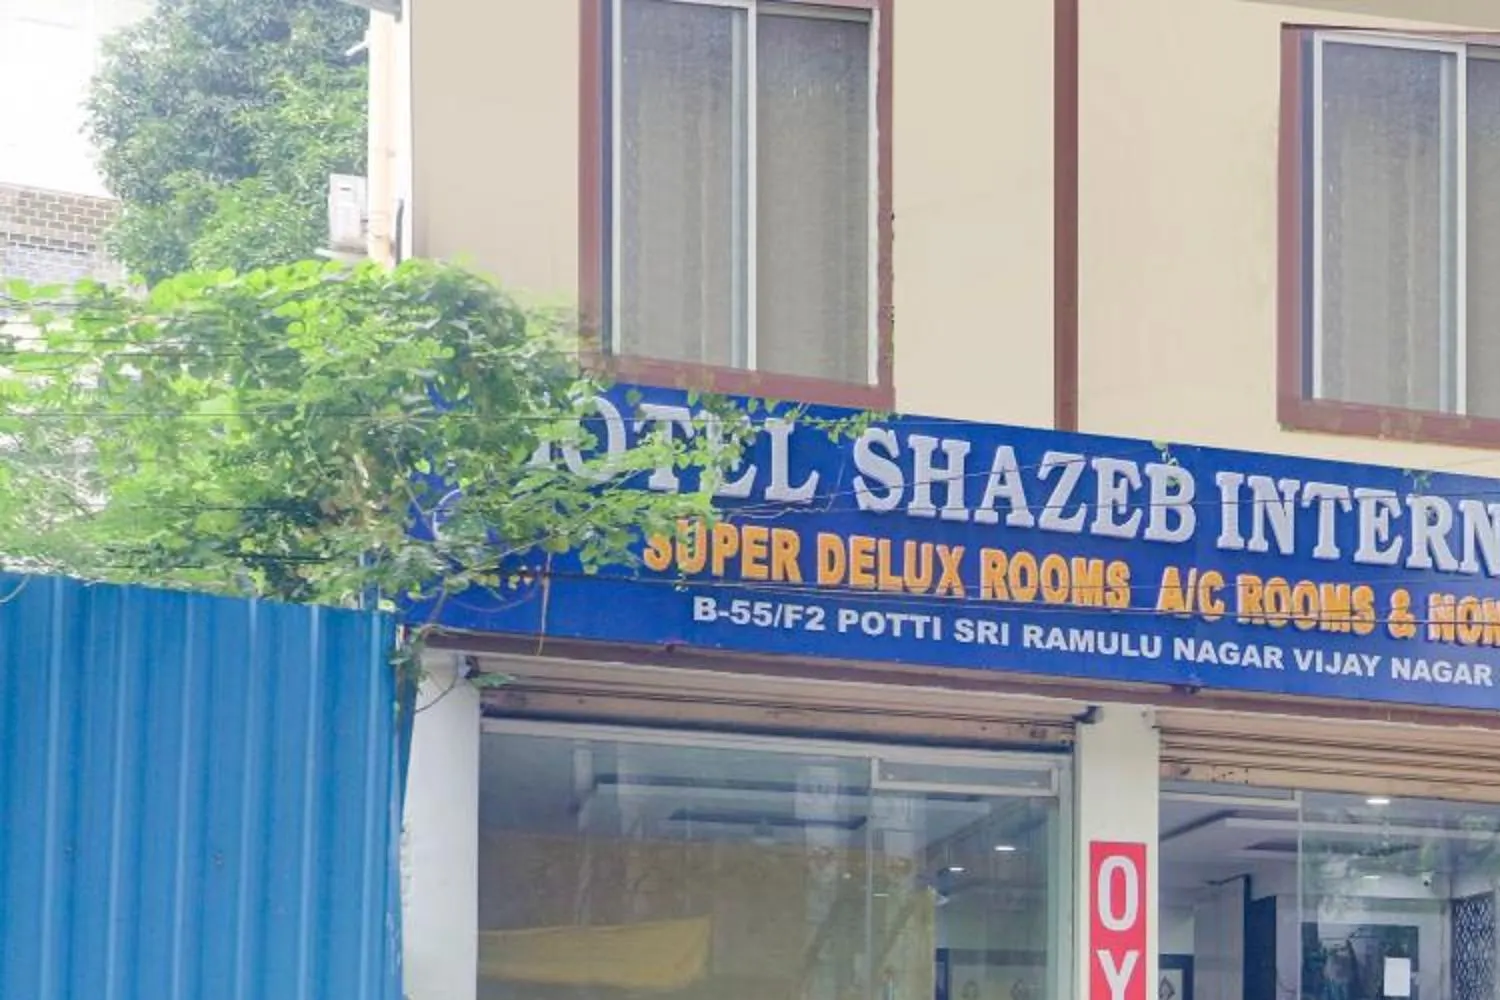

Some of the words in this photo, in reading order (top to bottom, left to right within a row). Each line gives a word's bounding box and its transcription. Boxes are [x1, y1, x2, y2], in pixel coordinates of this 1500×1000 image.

[528, 394, 819, 502] OTEL
[853, 427, 1197, 544] SHAZEB
[643, 516, 802, 585] SUPER
[816, 532, 966, 598] DELUX
[979, 547, 1131, 611] ROOMS
[1157, 565, 1226, 621] A/C
[1237, 574, 1375, 636] ROOMS
[1387, 588, 1417, 640] &
[692, 595, 826, 632] B-55/F2
[837, 608, 942, 641] POTTI
[953, 618, 1010, 647] SRI
[1022, 623, 1162, 659] RAMULU
[1173, 637, 1285, 670] NAGAR
[1293, 648, 1383, 677] VIJAY
[1390, 657, 1493, 687] NAGAR
